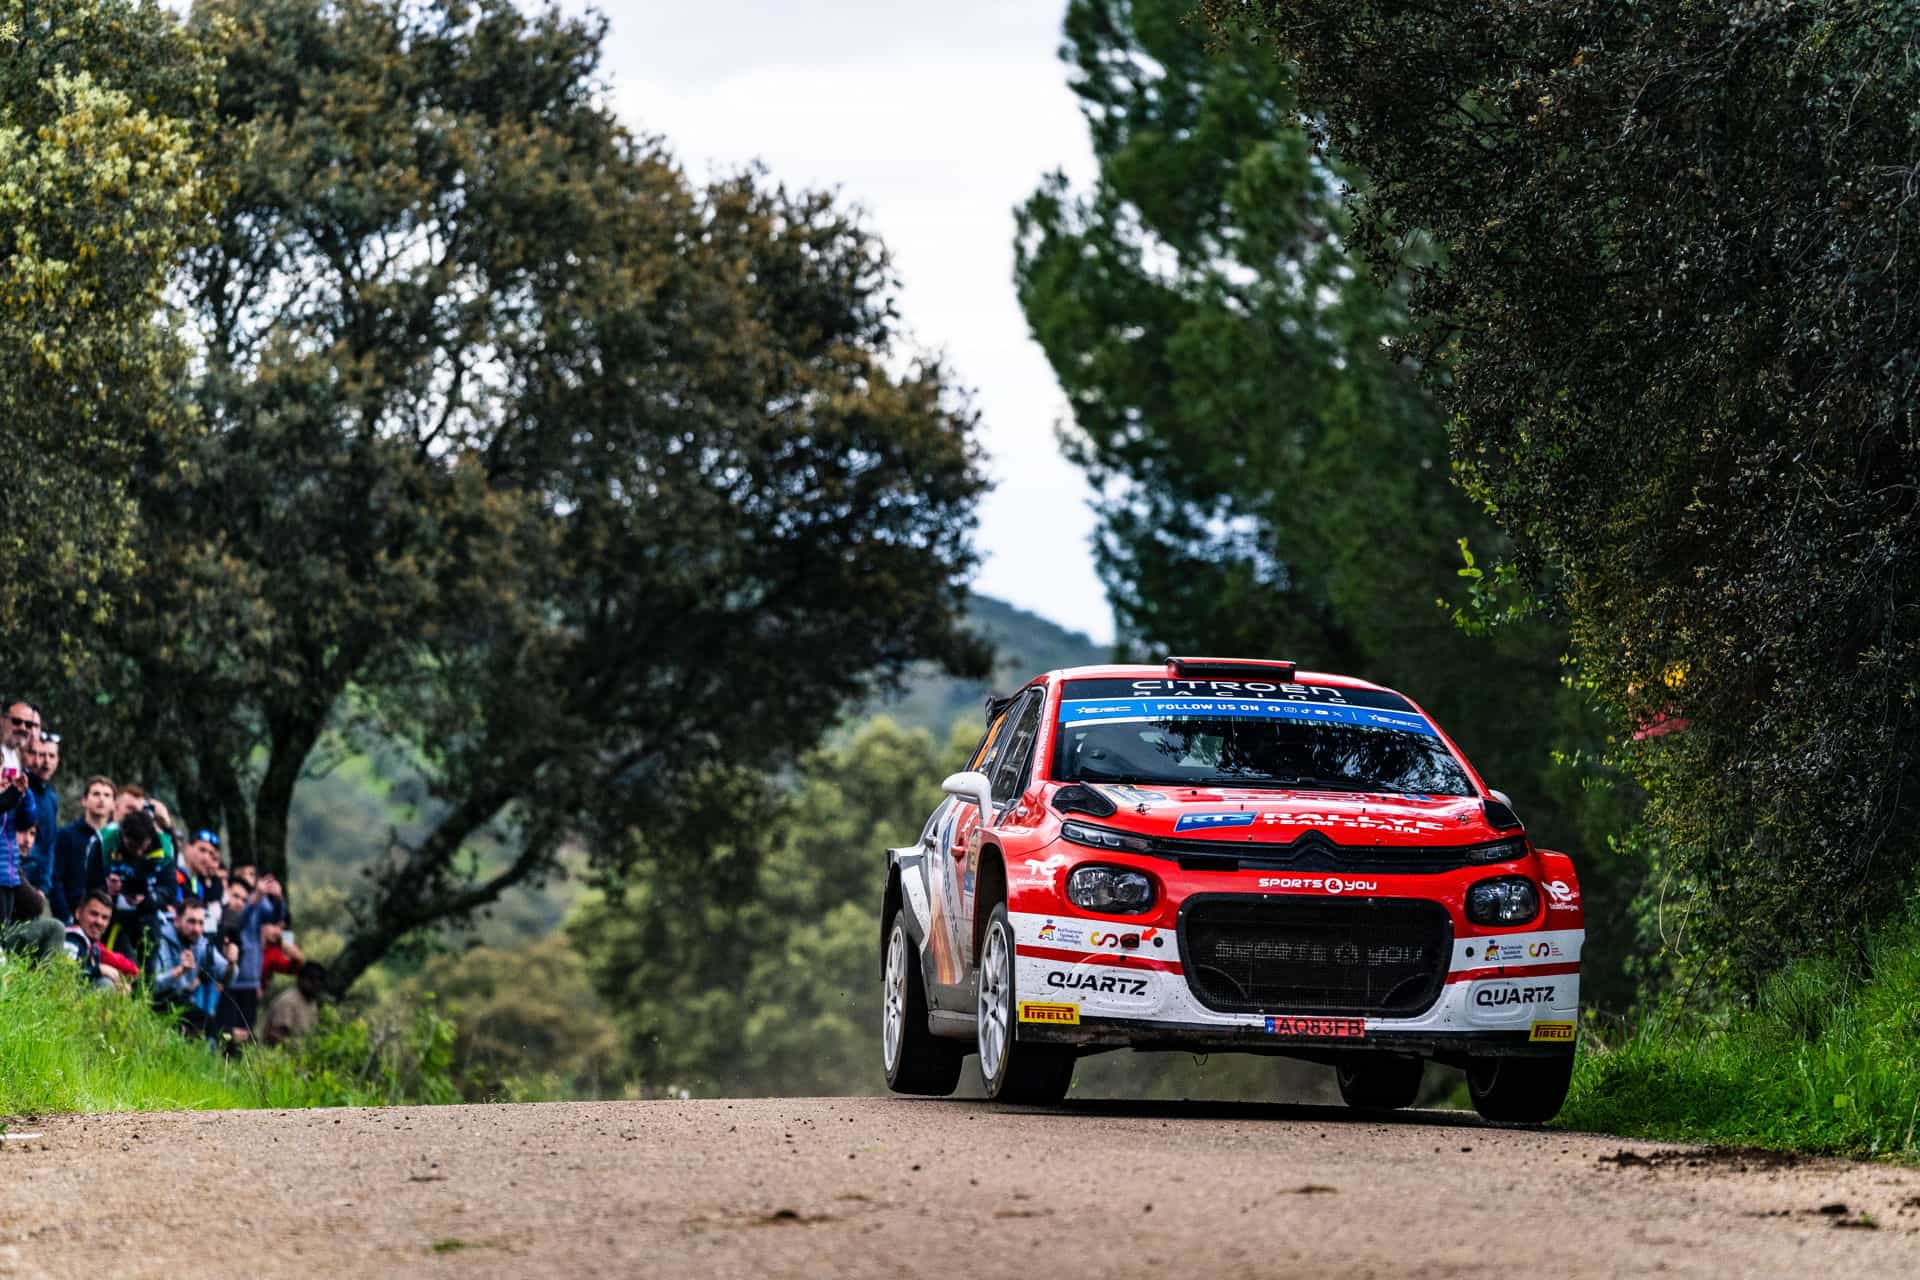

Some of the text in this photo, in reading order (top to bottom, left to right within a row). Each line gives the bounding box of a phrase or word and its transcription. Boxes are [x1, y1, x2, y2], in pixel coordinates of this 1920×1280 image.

[1133, 690, 1347, 704] RACING
[1157, 703, 1260, 712] FOLLOW US ON
[1263, 812, 1444, 831] RALLYE
[1263, 819, 1420, 834] TEAM SPAIN
[1047, 971, 1148, 996] QUARTZ
[1476, 986, 1555, 1007] QUARTZ
[1023, 1005, 1074, 1021] PIRELLI
[1533, 1024, 1573, 1038] PIRELLI
